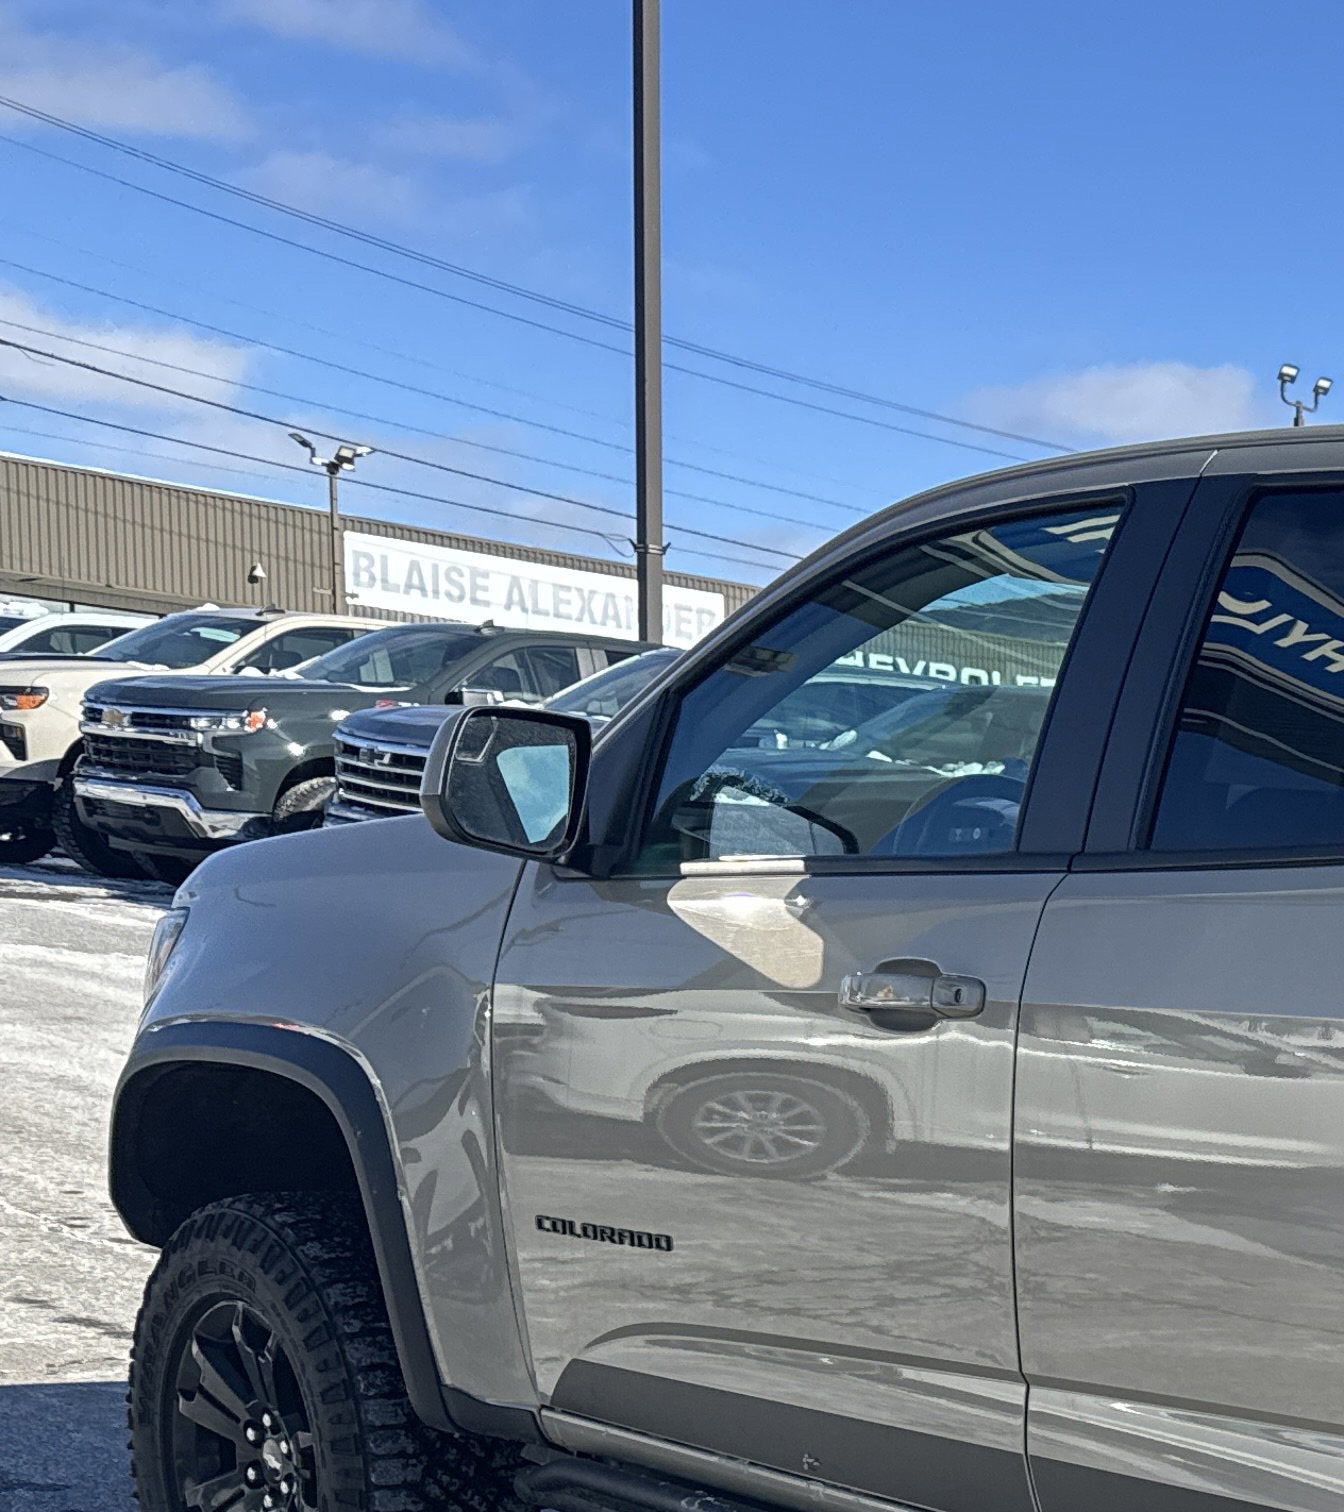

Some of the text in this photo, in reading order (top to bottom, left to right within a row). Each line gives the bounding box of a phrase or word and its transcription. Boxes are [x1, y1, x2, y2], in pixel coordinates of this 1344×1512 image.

[351, 549, 717, 640] BLAISE ALEXAER
[834, 650, 1057, 687] EVROL
[535, 1214, 674, 1252] COLORADO
